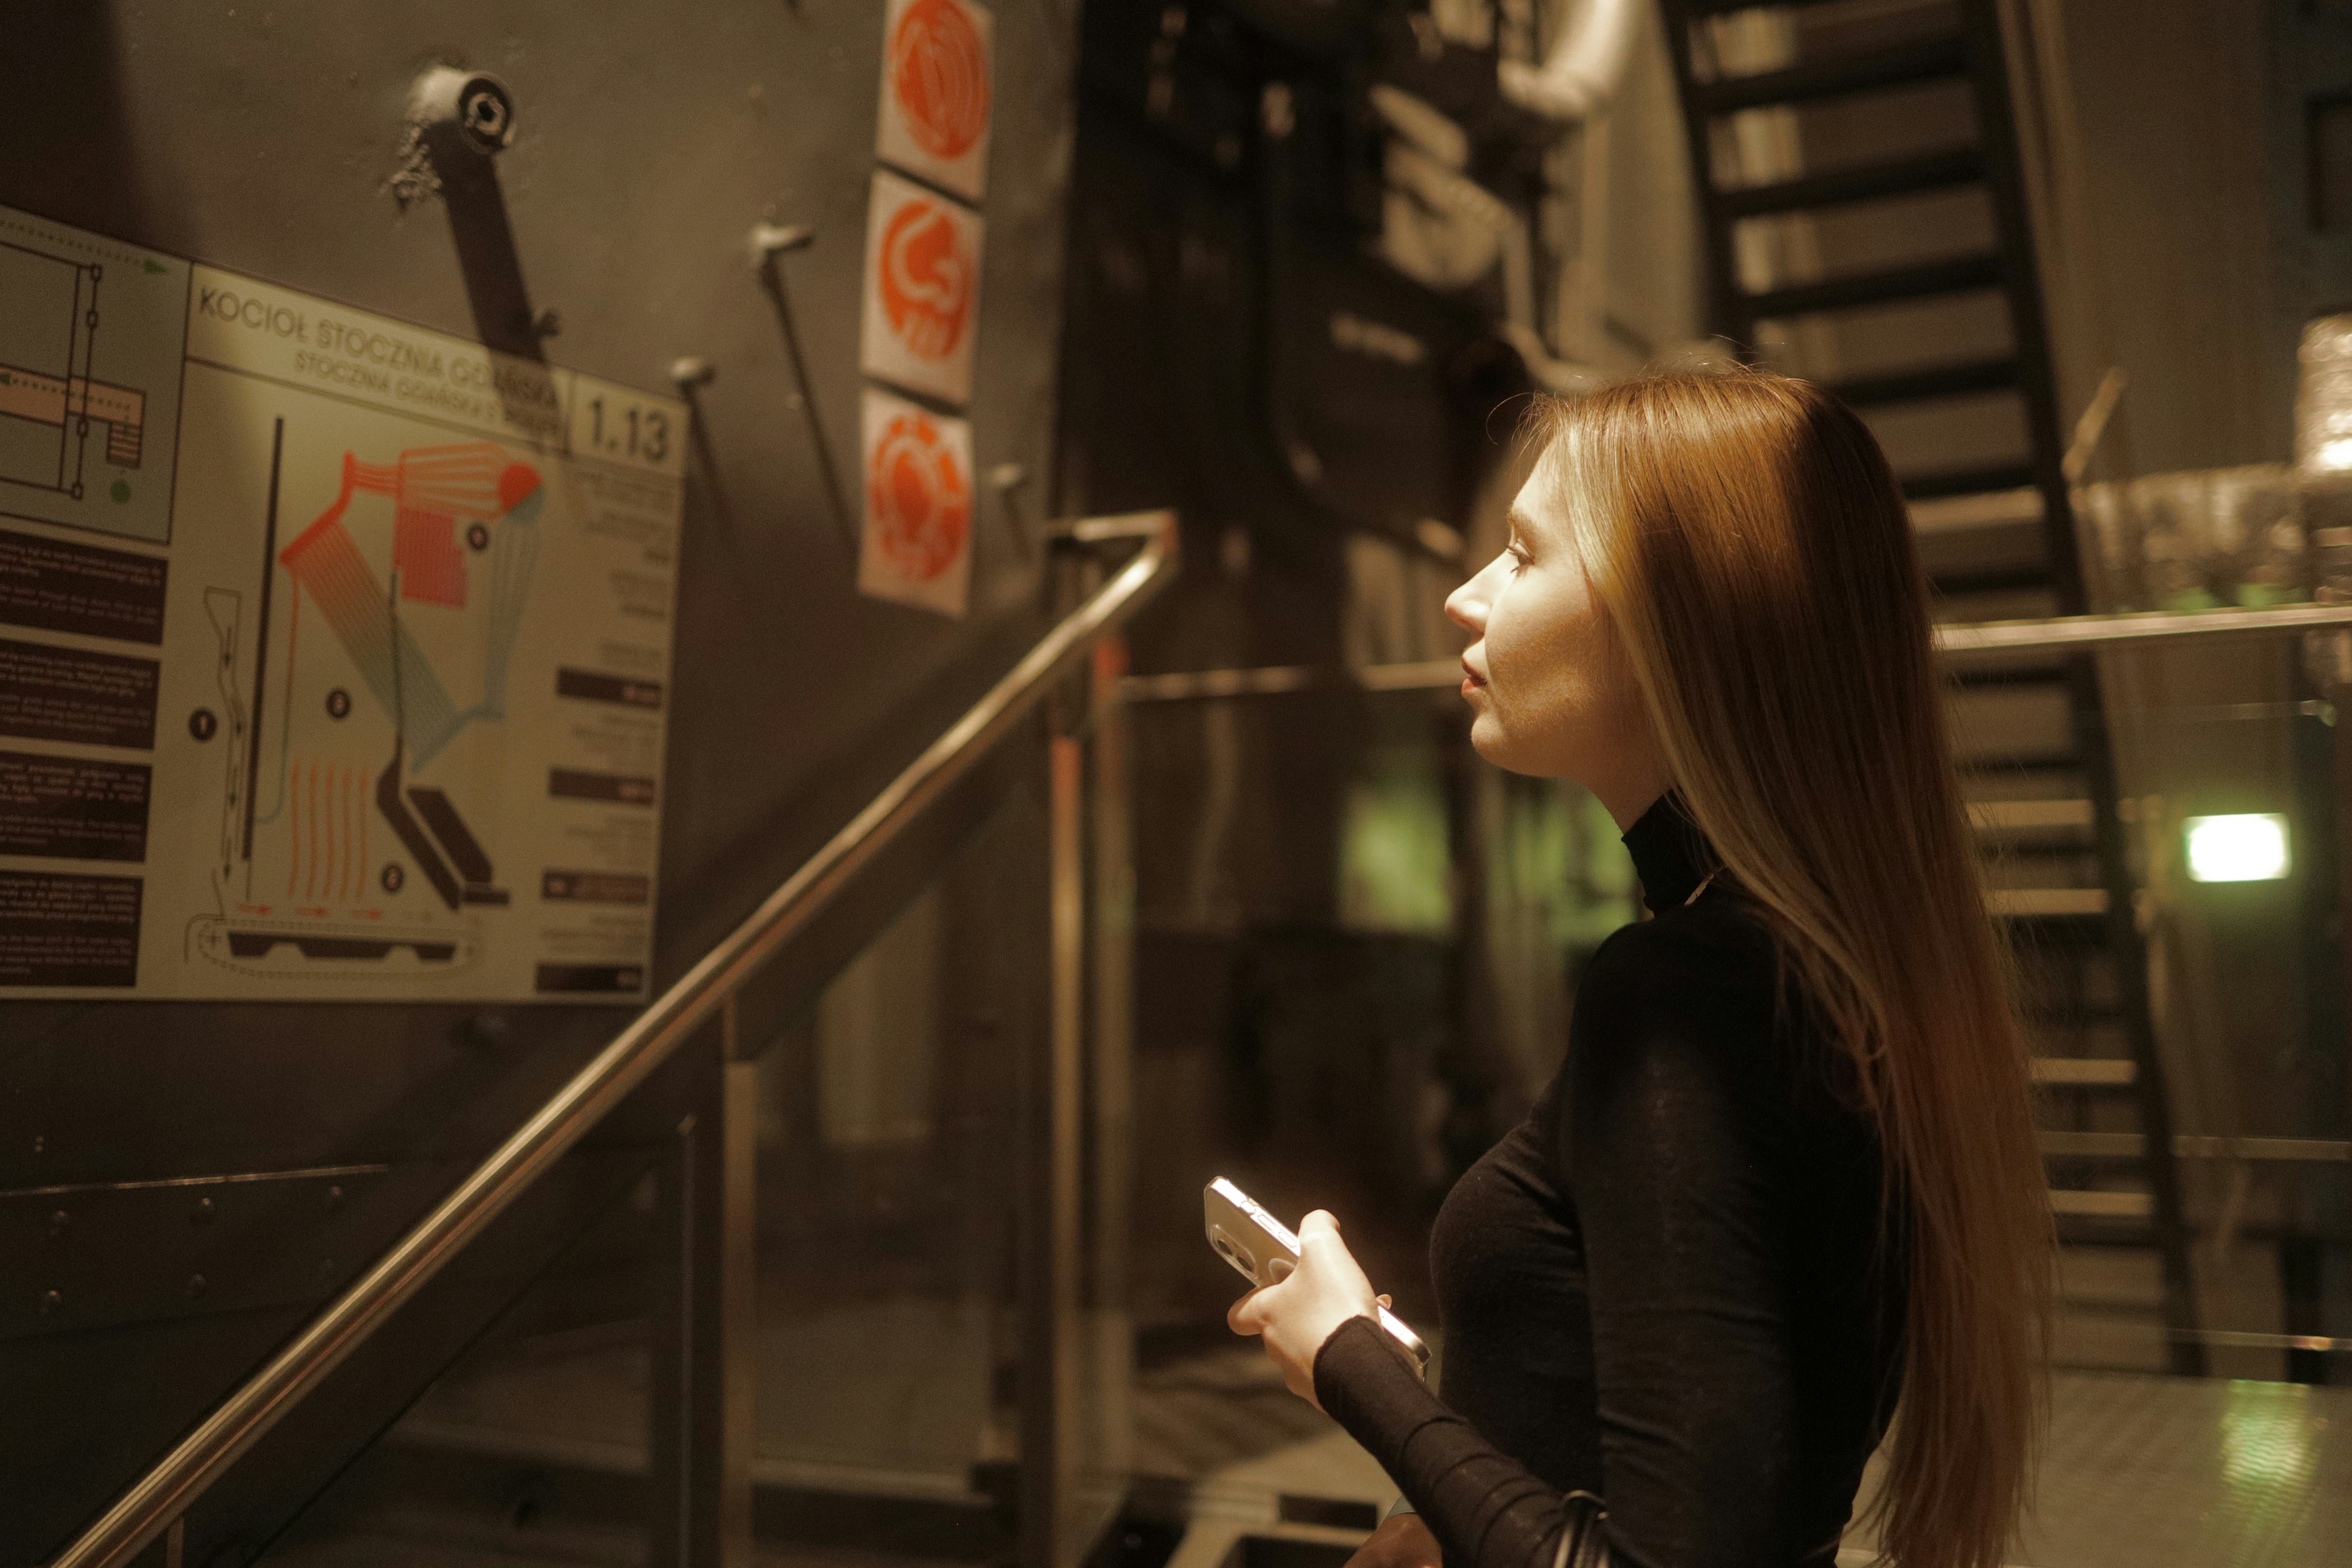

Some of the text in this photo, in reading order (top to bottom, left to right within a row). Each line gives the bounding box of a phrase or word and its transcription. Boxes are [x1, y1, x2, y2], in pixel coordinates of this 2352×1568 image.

[198, 286, 309, 341] KOCIOŁ
[316, 319, 445, 379] STOCZNIA
[293, 349, 392, 394] STOCZNIA
[587, 396, 671, 463] 1.13
